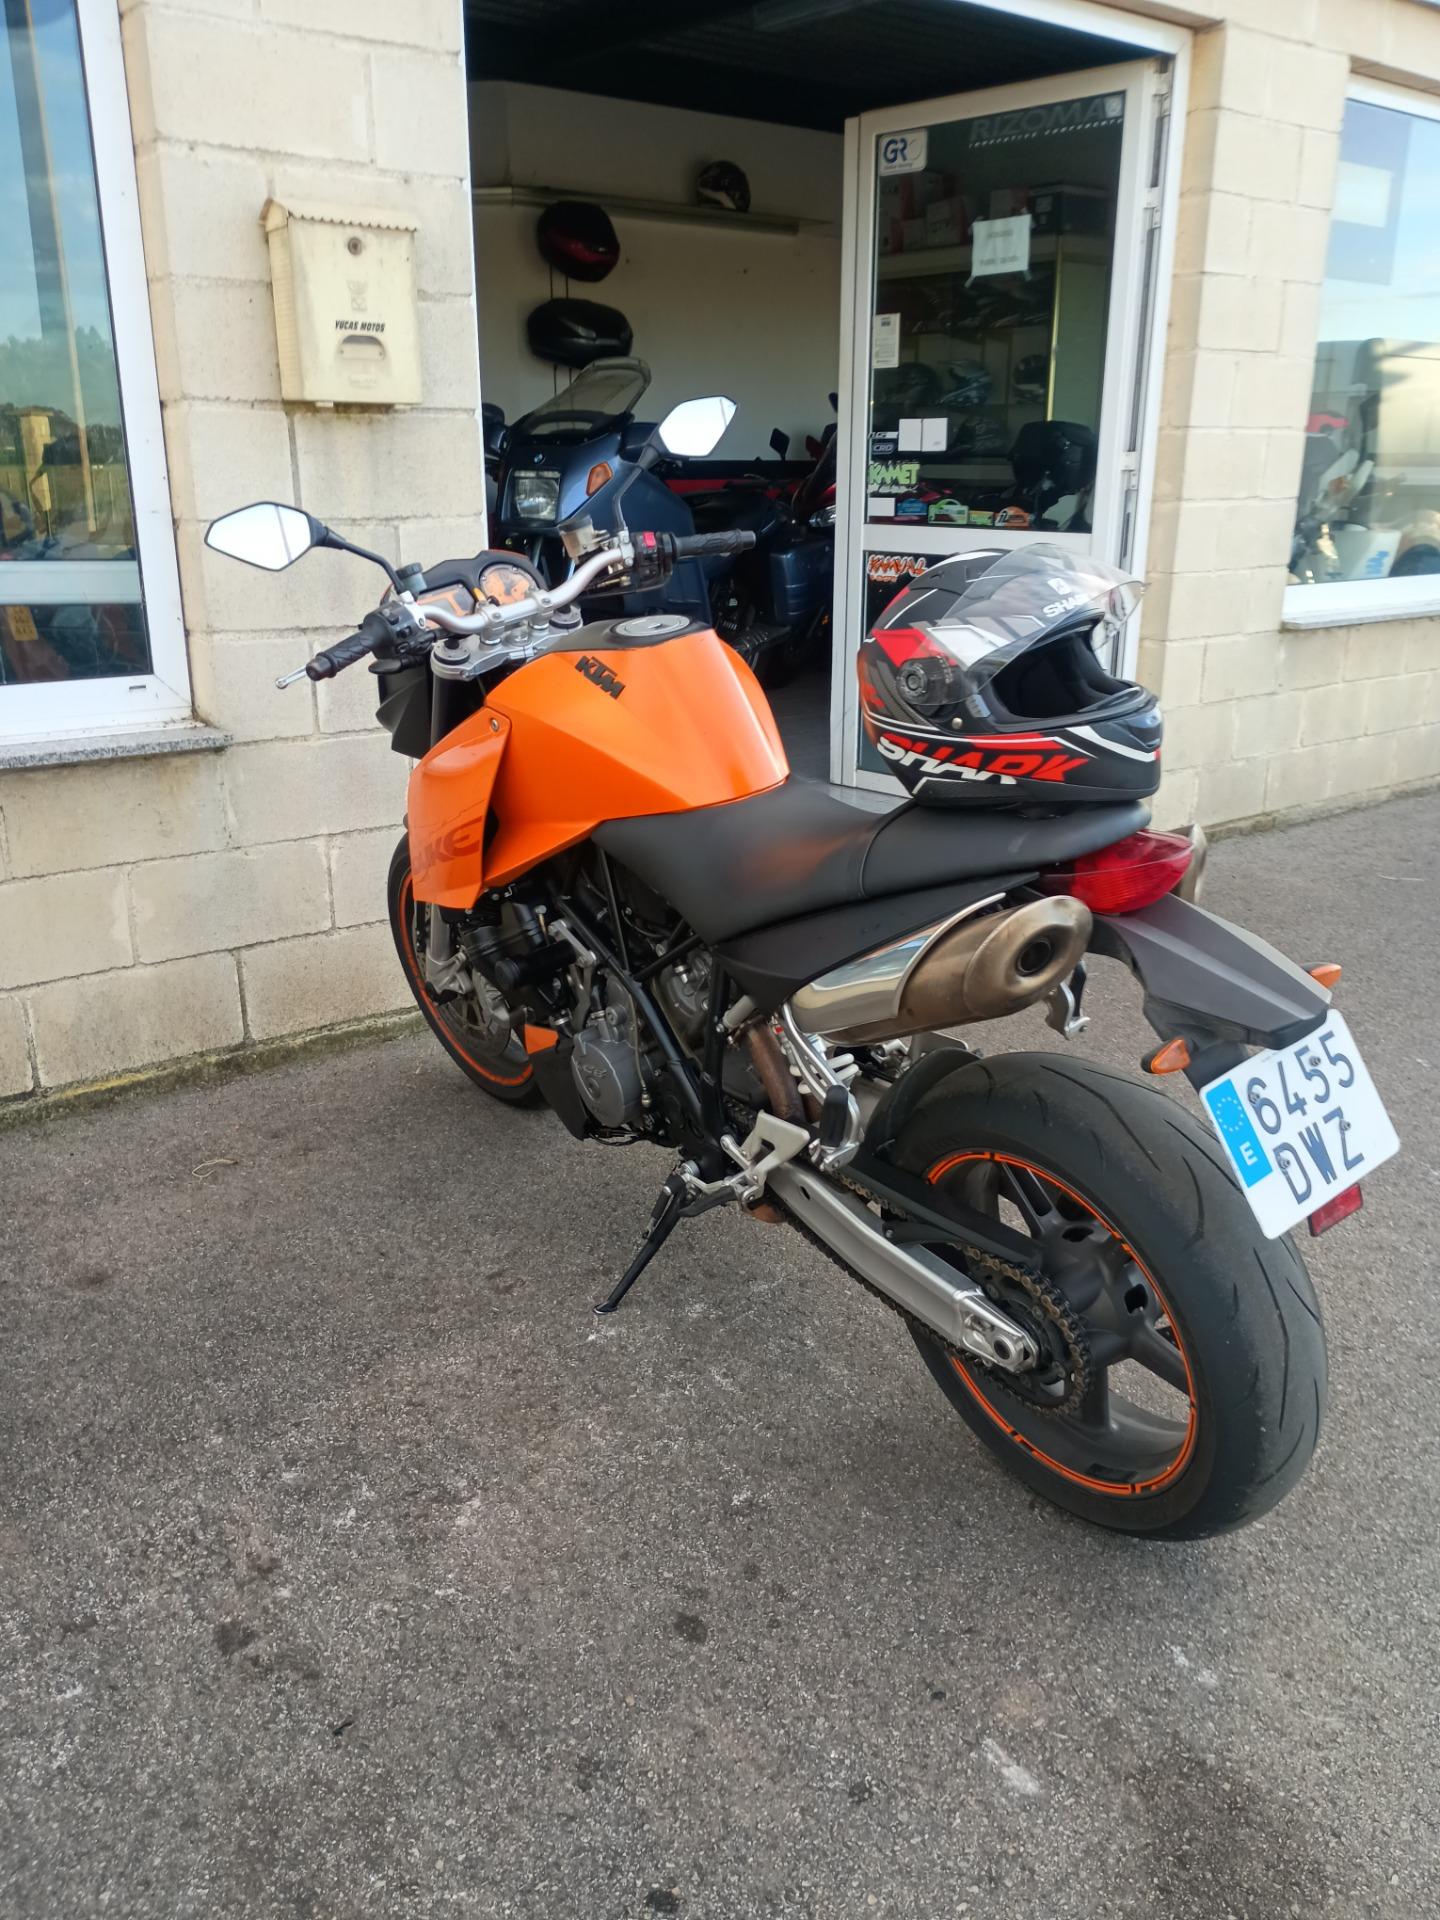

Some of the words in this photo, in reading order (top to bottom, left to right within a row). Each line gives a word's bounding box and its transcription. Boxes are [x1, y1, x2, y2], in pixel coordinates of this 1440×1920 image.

[360, 322, 385, 333] MOTOS
[575, 655, 626, 699] KTM
[1247, 1030, 1355, 1135] 6455
[1239, 1140, 1258, 1166] E
[1273, 1106, 1365, 1205] DWZ
